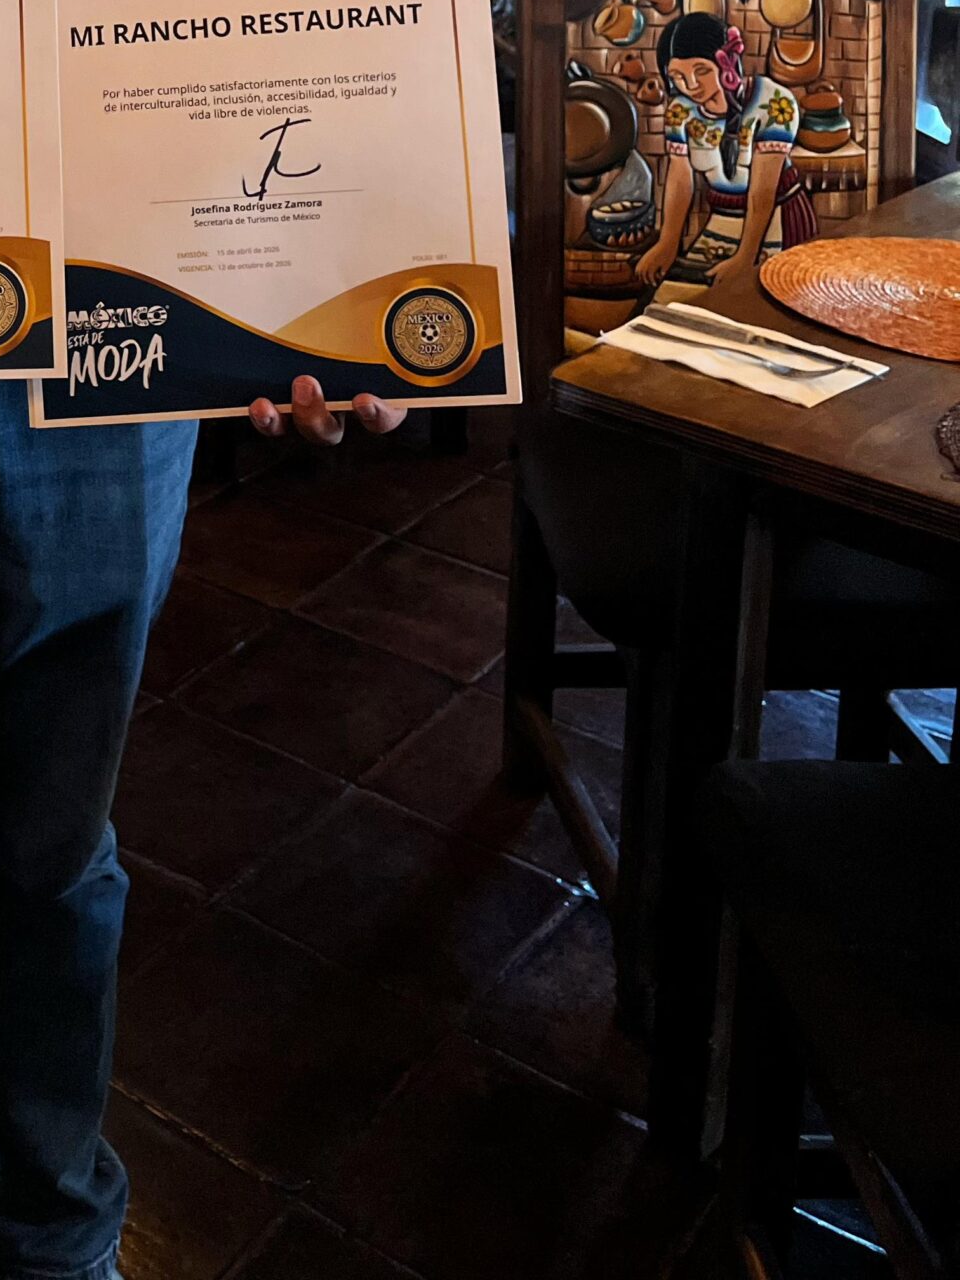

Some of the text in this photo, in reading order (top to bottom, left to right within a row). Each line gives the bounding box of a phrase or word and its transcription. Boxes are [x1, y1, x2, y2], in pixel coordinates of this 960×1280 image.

[70, 3, 423, 48] MI RANCHO RESTAURANT
[103, 71, 396, 99] Por haber cumplido satisfactoriamente con los criterios
[104, 84, 397, 113] de interculturalidad, inclusión, accesibilidad, igualdad y
[189, 104, 312, 120] vida libre de violencias.
[191, 199, 322, 216] Josefina Rodríguez Zamora
[194, 212, 320, 228] Secretaria de Turismo de México
[407, 313, 452, 324] MEXICO
[68, 331, 104, 349] ESTÁ DE
[420, 344, 443, 354] 2026
[69, 333, 167, 397] MODA
